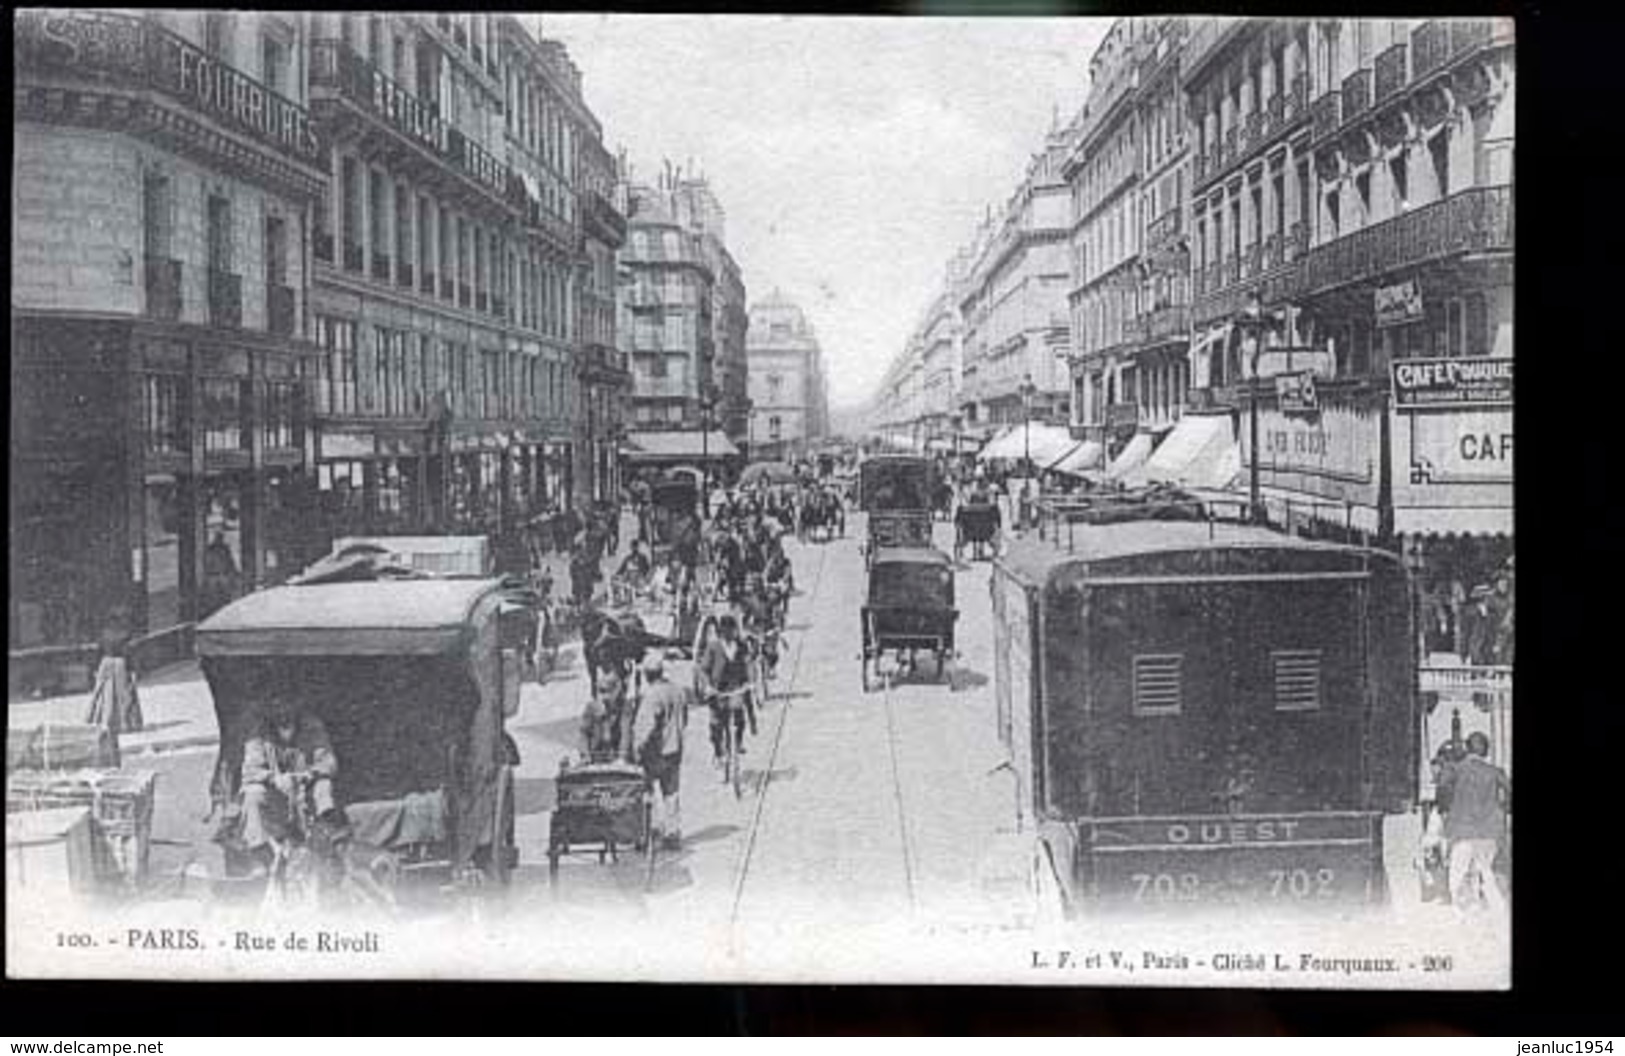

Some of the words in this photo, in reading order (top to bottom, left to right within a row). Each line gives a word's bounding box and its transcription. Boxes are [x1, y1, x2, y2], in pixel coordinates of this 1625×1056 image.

[178, 46, 321, 161] FOURRURES
[1167, 822, 1300, 843] OUEST
[1266, 868, 1337, 900] 702
